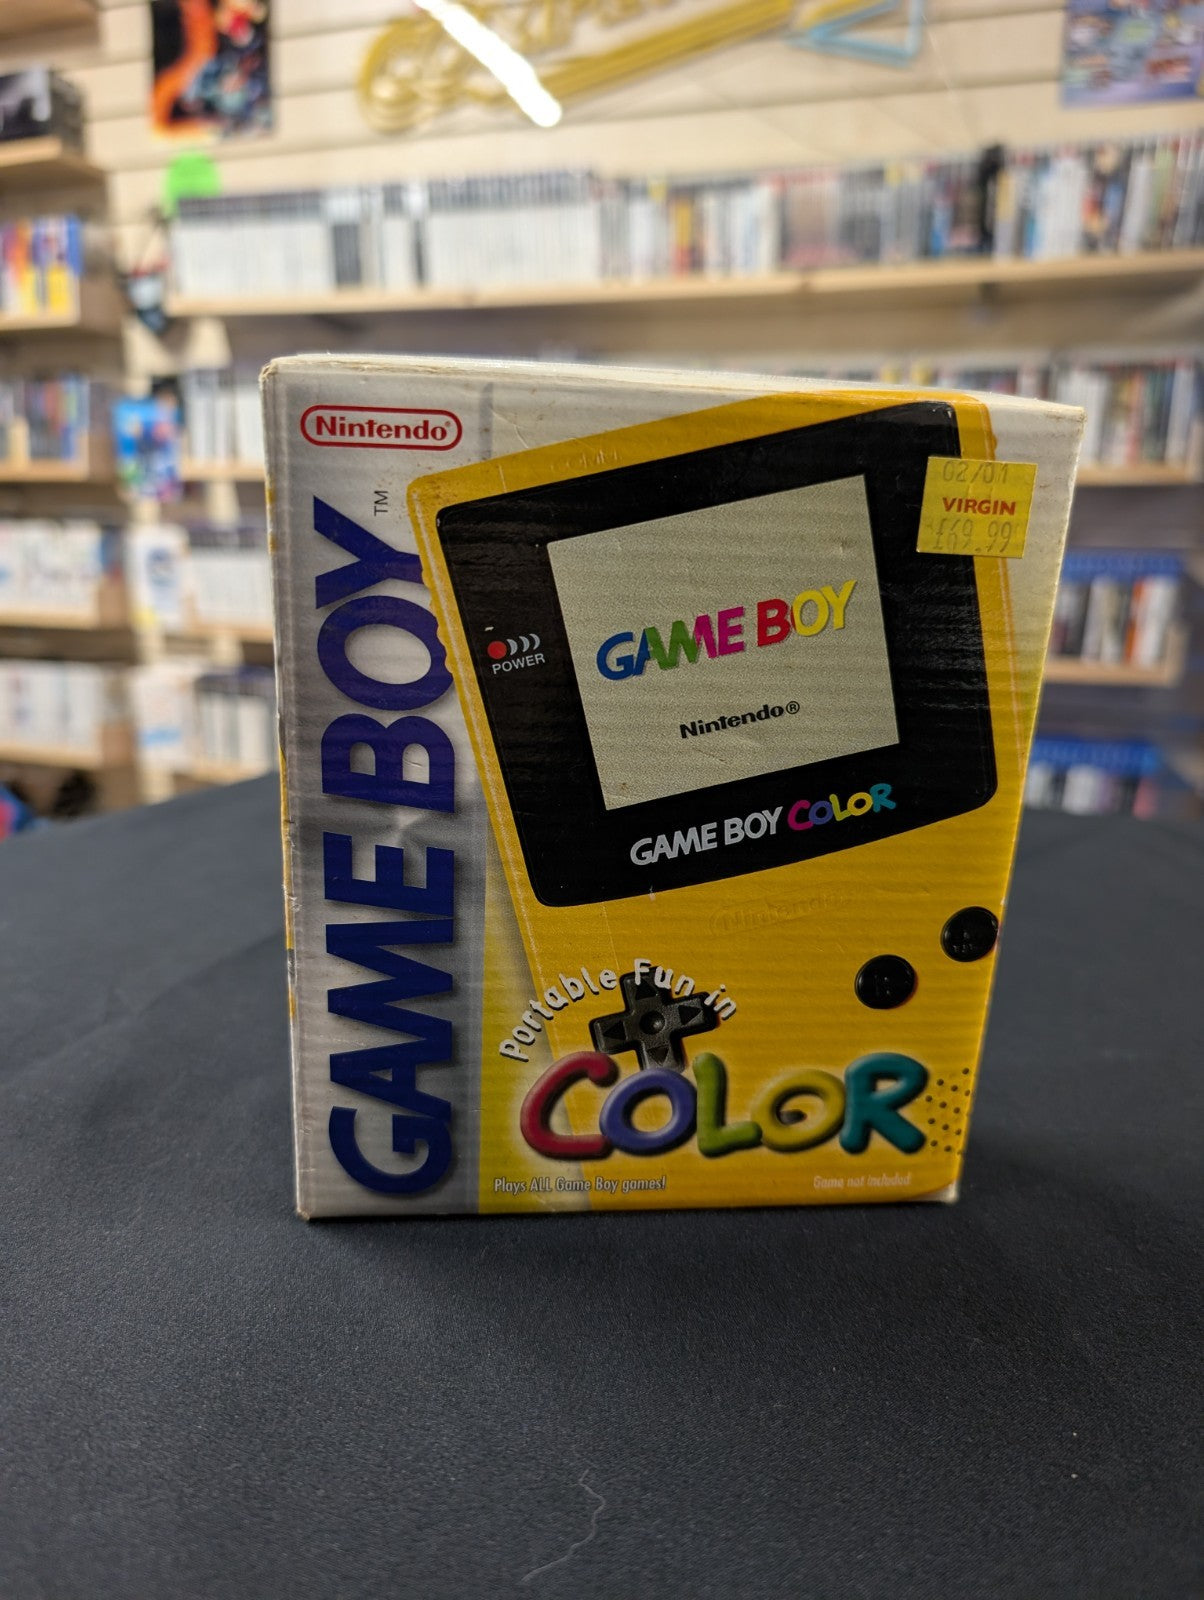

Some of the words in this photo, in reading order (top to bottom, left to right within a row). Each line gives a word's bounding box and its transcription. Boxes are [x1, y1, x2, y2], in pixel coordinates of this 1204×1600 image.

[942, 460, 1009, 484] 02/01
[942, 497, 1017, 516] VIRGIN
[313, 494, 455, 814] BOY
[492, 653, 546, 675] POWER
[596, 605, 745, 681] GAME
[757, 579, 857, 647] BOY
[630, 822, 718, 866] GAME
[724, 806, 783, 845] BOY
[787, 783, 897, 831] COLOR
[323, 831, 455, 1195] GAME
[499, 966, 618, 1062] Portable
[633, 957, 696, 997] Fun
[704, 984, 738, 1021] in
[519, 1050, 929, 1161] COLOR
[494, 1176, 526, 1195] Plays
[530, 1177, 553, 1192] ALL
[556, 1176, 591, 1192] Game
[595, 1176, 619, 1194] Boy
[622, 1175, 667, 1194] games!
[813, 1175, 845, 1190] Game
[847, 1174, 866, 1188] not
[867, 1171, 912, 1188] included
